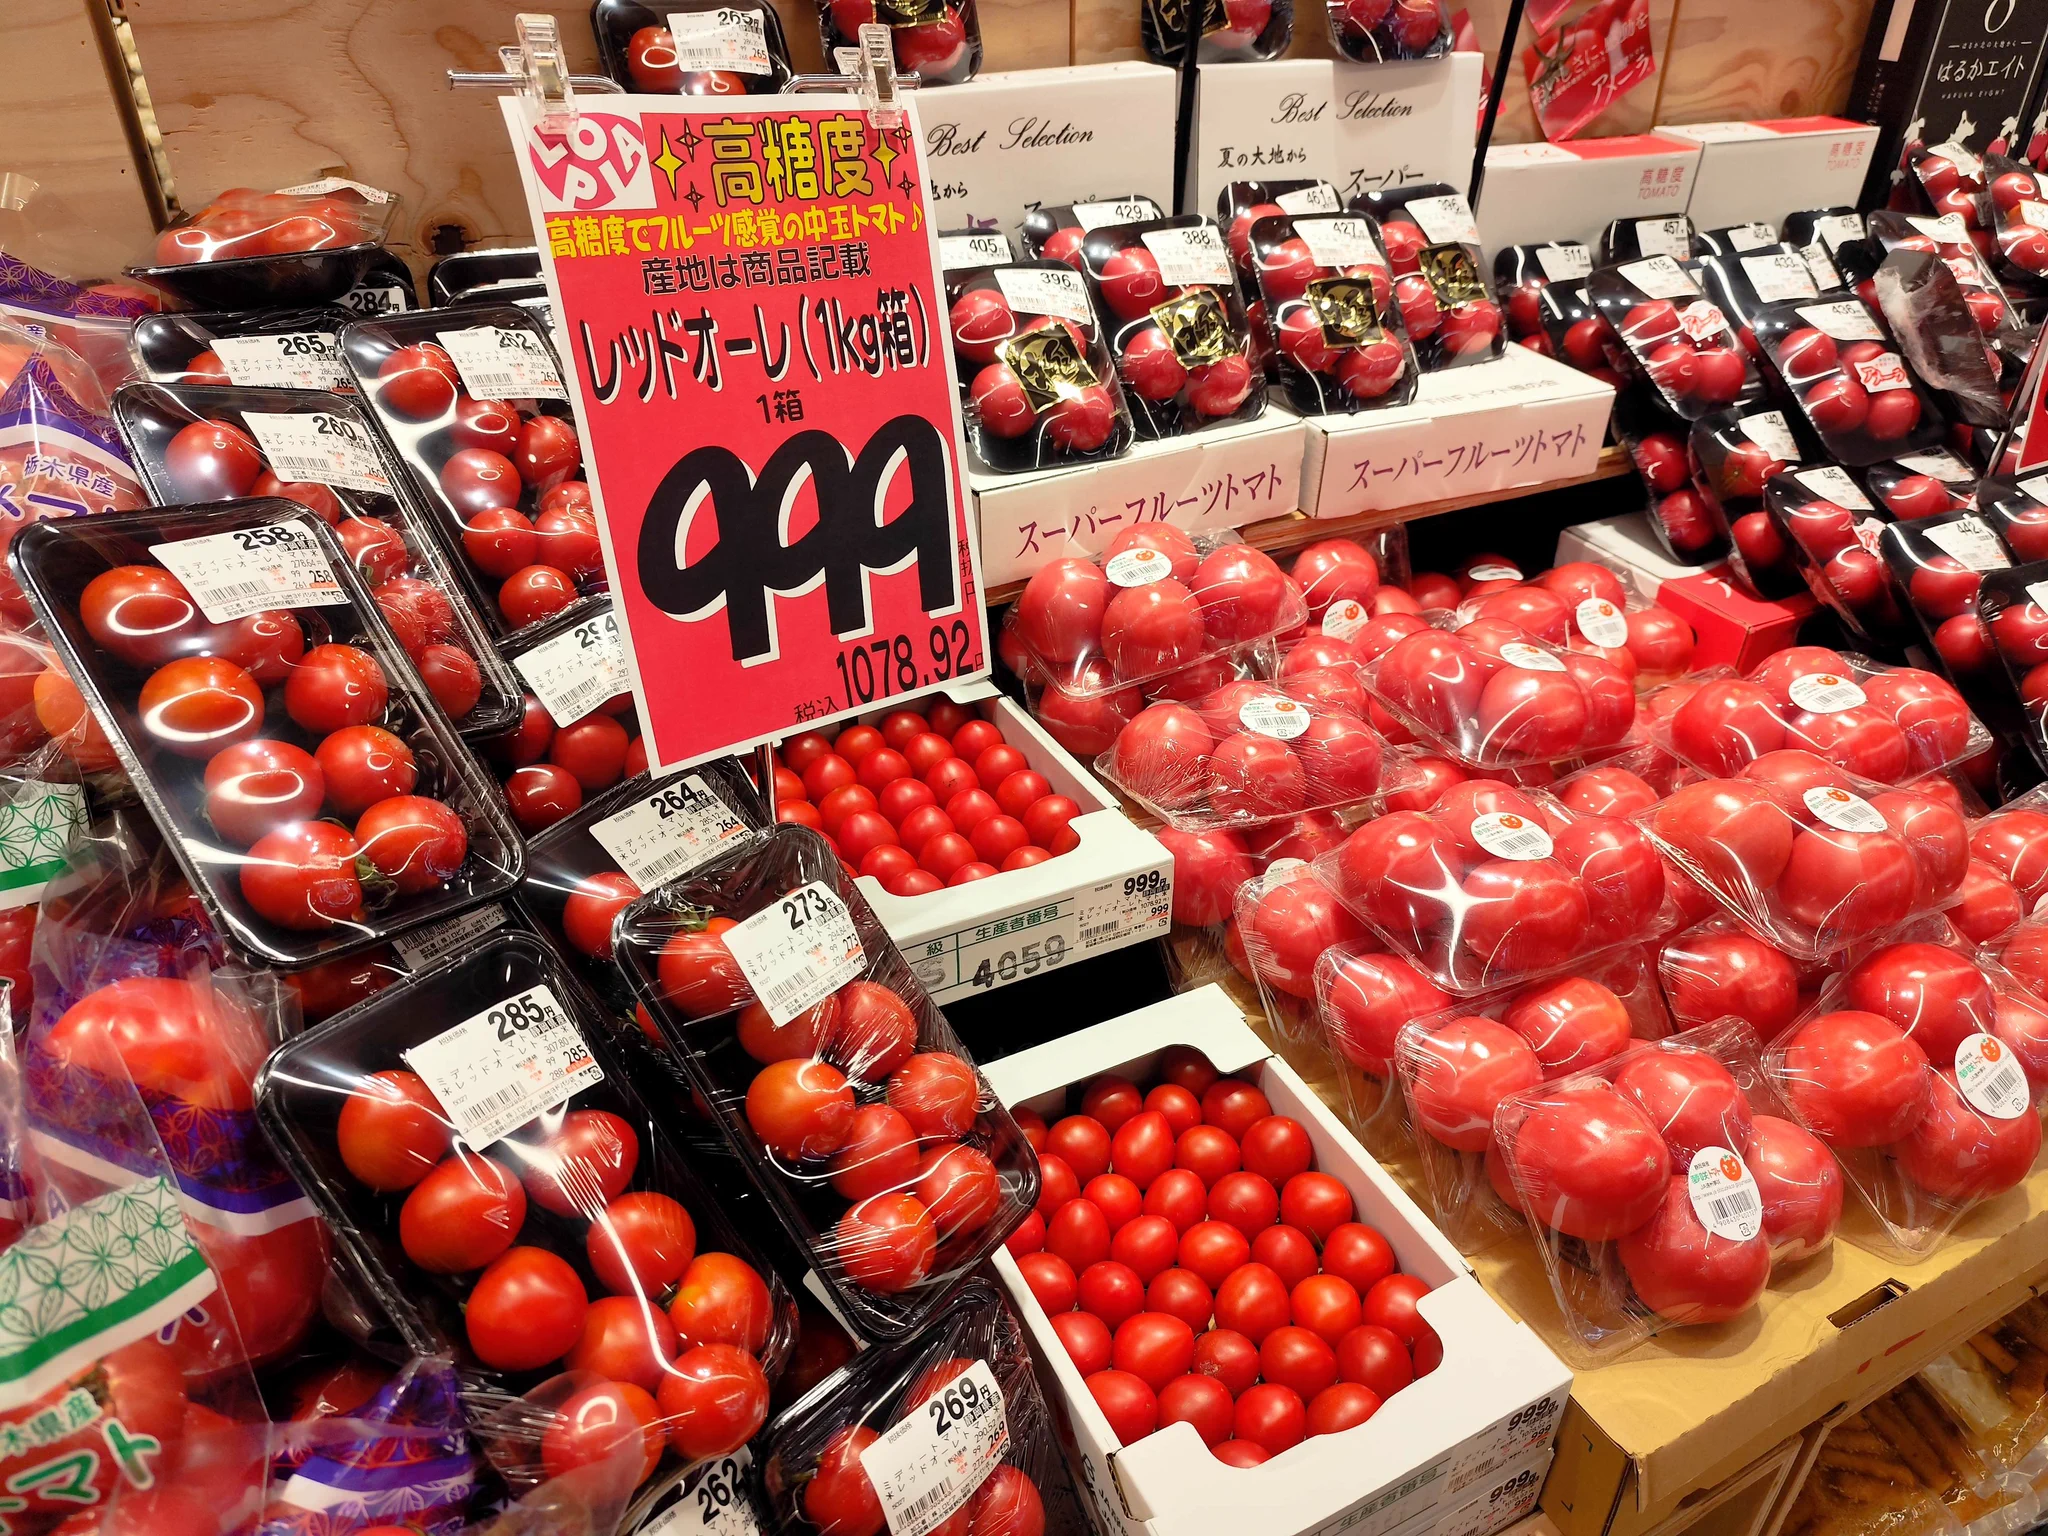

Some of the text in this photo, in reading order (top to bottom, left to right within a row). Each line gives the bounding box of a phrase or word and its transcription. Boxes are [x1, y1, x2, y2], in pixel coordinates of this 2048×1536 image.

[1937, 54, 2025, 82] はるかエイト
[1271, 90, 1413, 125] Best Selection
[923, 117, 1095, 157] Best Selection
[702, 114, 873, 208] 高糖度
[1217, 144, 1306, 168] 夏の大地から
[1637, 185, 1680, 200] TOMATO
[1639, 166, 1684, 186] 高糖度
[641, 242, 871, 296] 産地は商品記載
[756, 390, 804, 424] 1箱
[1348, 422, 1588, 493] スーパーフルーツトマト
[24, 454, 116, 498] 栃木県産
[0, 483, 118, 524] トマ
[1016, 463, 1285, 560] スーパーフルーツトマト
[637, 414, 962, 667] 999
[309, 569, 333, 583] 258
[650, 782, 708, 820] 264円
[716, 815, 739, 833] 264
[1123, 870, 1167, 896] 999円
[782, 888, 836, 930] 273円
[975, 906, 1059, 941] 生産者番号
[1151, 903, 1169, 917] 999
[843, 933, 859, 951] 273
[972, 934, 1065, 988] 4059
[488, 994, 555, 1042] 285円
[436, 1035, 527, 1087] ミディートマト
[546, 1057, 556, 1067] 99
[563, 1044, 588, 1066] 285
[549, 1068, 565, 1081] 288
[929, 1377, 991, 1436] 269円
[973, 1445, 982, 1456] 99
[987, 1421, 1005, 1448] 269
[1531, 1425, 1552, 1441] 999
[1340, 1467, 1438, 1528] 生産者番号
